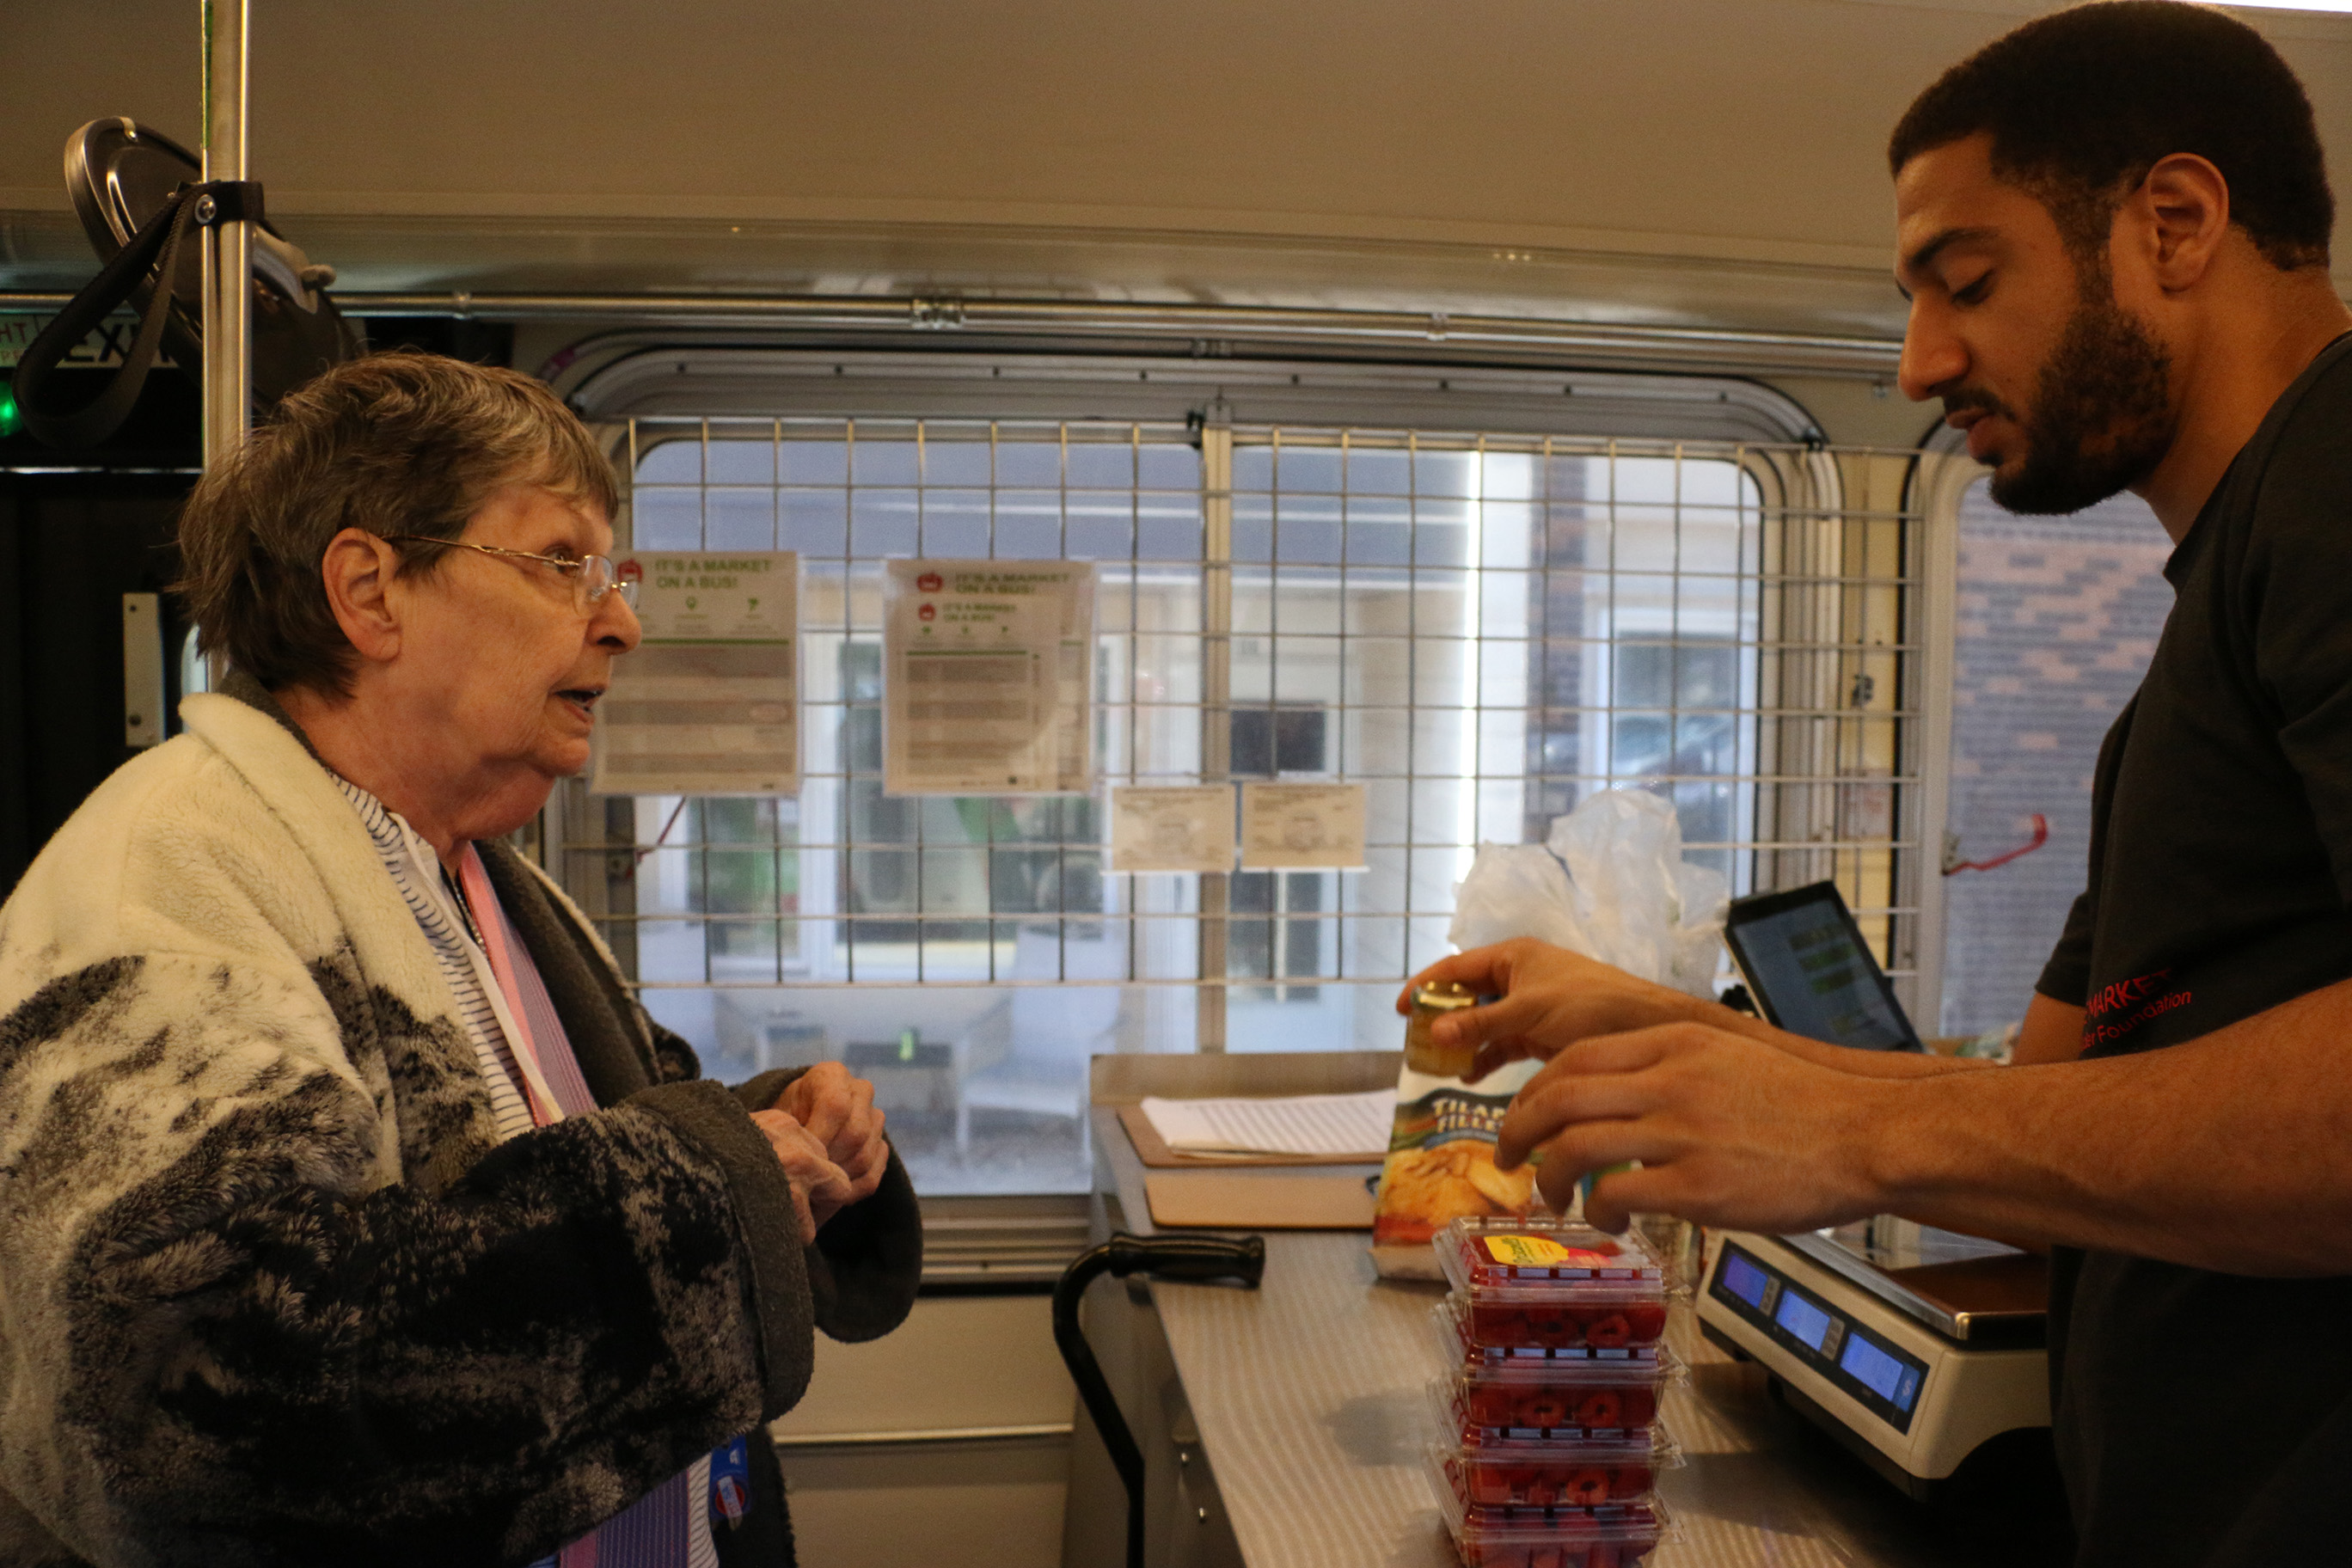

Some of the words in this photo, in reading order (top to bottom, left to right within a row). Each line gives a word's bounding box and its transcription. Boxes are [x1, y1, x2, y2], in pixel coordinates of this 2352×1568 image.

[689, 559, 699, 571] A
[703, 560, 770, 572] MARKET
[656, 576, 680, 588] ON
[685, 577, 695, 589] A
[2097, 990, 2193, 1044] Foundation
[1431, 1098, 1506, 1119] TILAP
[1437, 1115, 1504, 1133] FILLE
